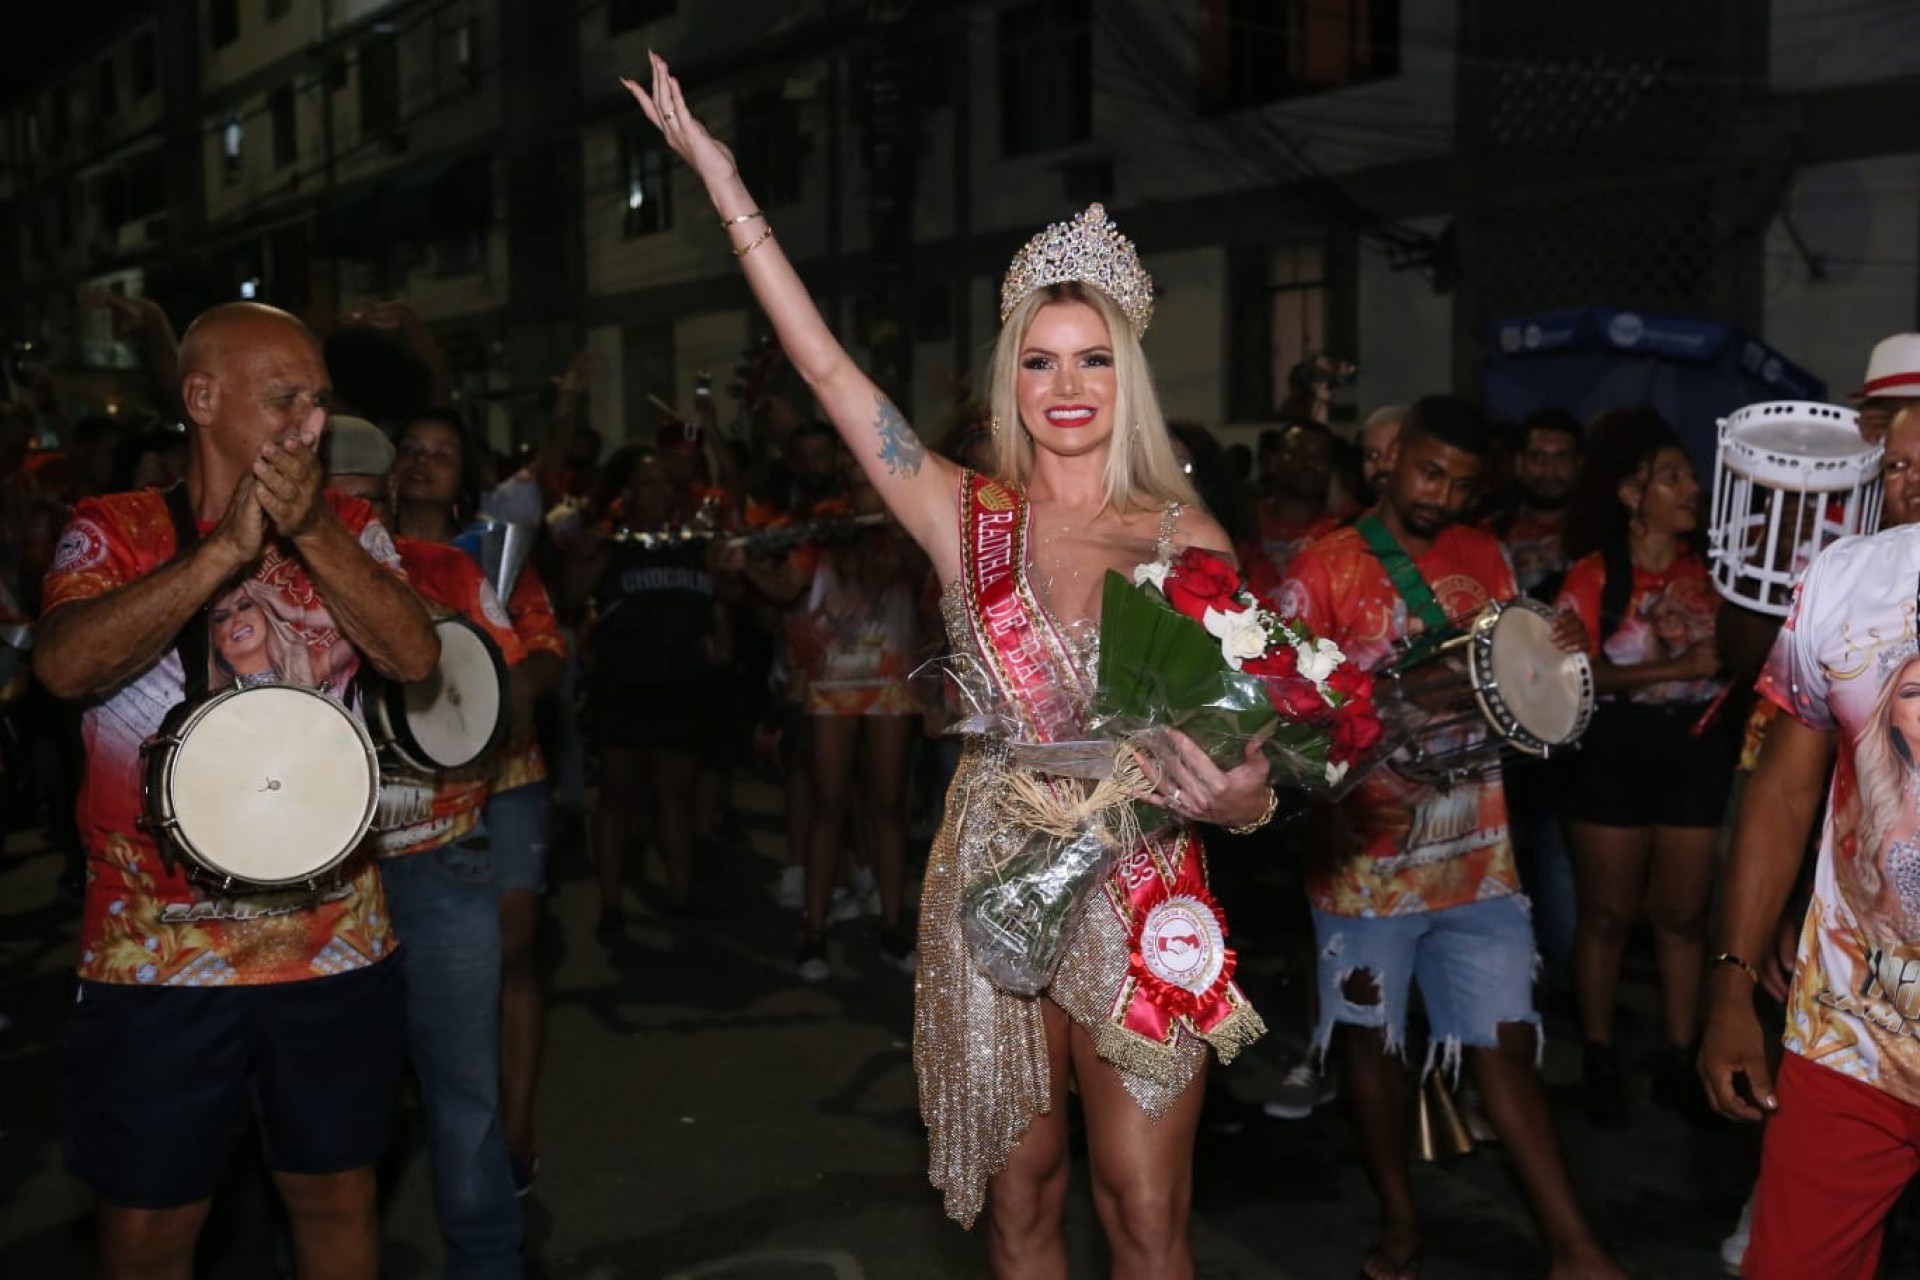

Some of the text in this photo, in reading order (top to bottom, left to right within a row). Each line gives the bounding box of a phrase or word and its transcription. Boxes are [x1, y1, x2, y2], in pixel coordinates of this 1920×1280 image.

[977, 510, 1074, 744] RAINHA DE BATER
